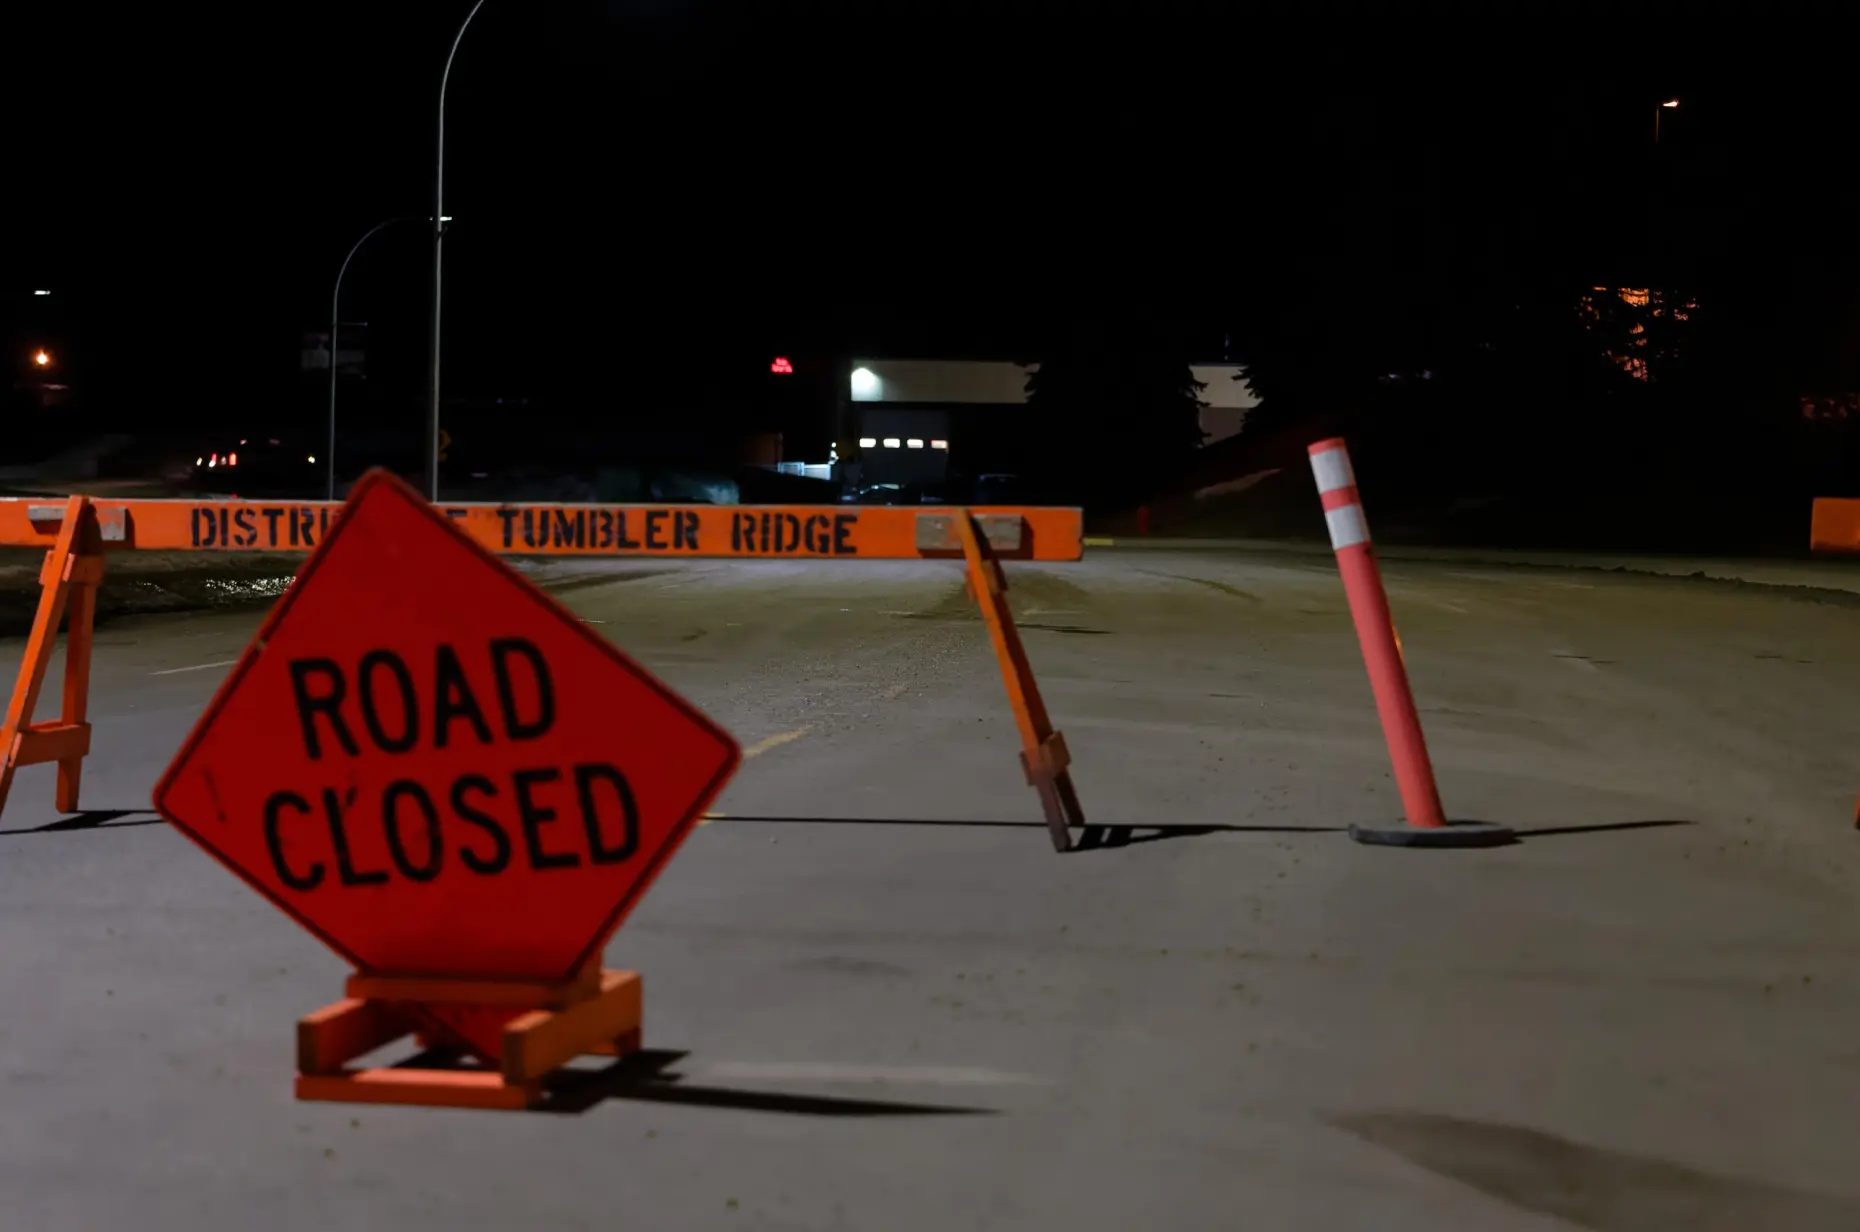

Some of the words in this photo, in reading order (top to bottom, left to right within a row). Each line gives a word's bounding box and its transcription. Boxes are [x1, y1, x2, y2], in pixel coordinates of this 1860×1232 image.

[192, 508, 328, 547] DISTRI
[496, 509, 700, 550] TUMBLER
[732, 512, 858, 553] RIDGE
[290, 636, 556, 760] ROAD
[264, 763, 638, 890] CLOSED
